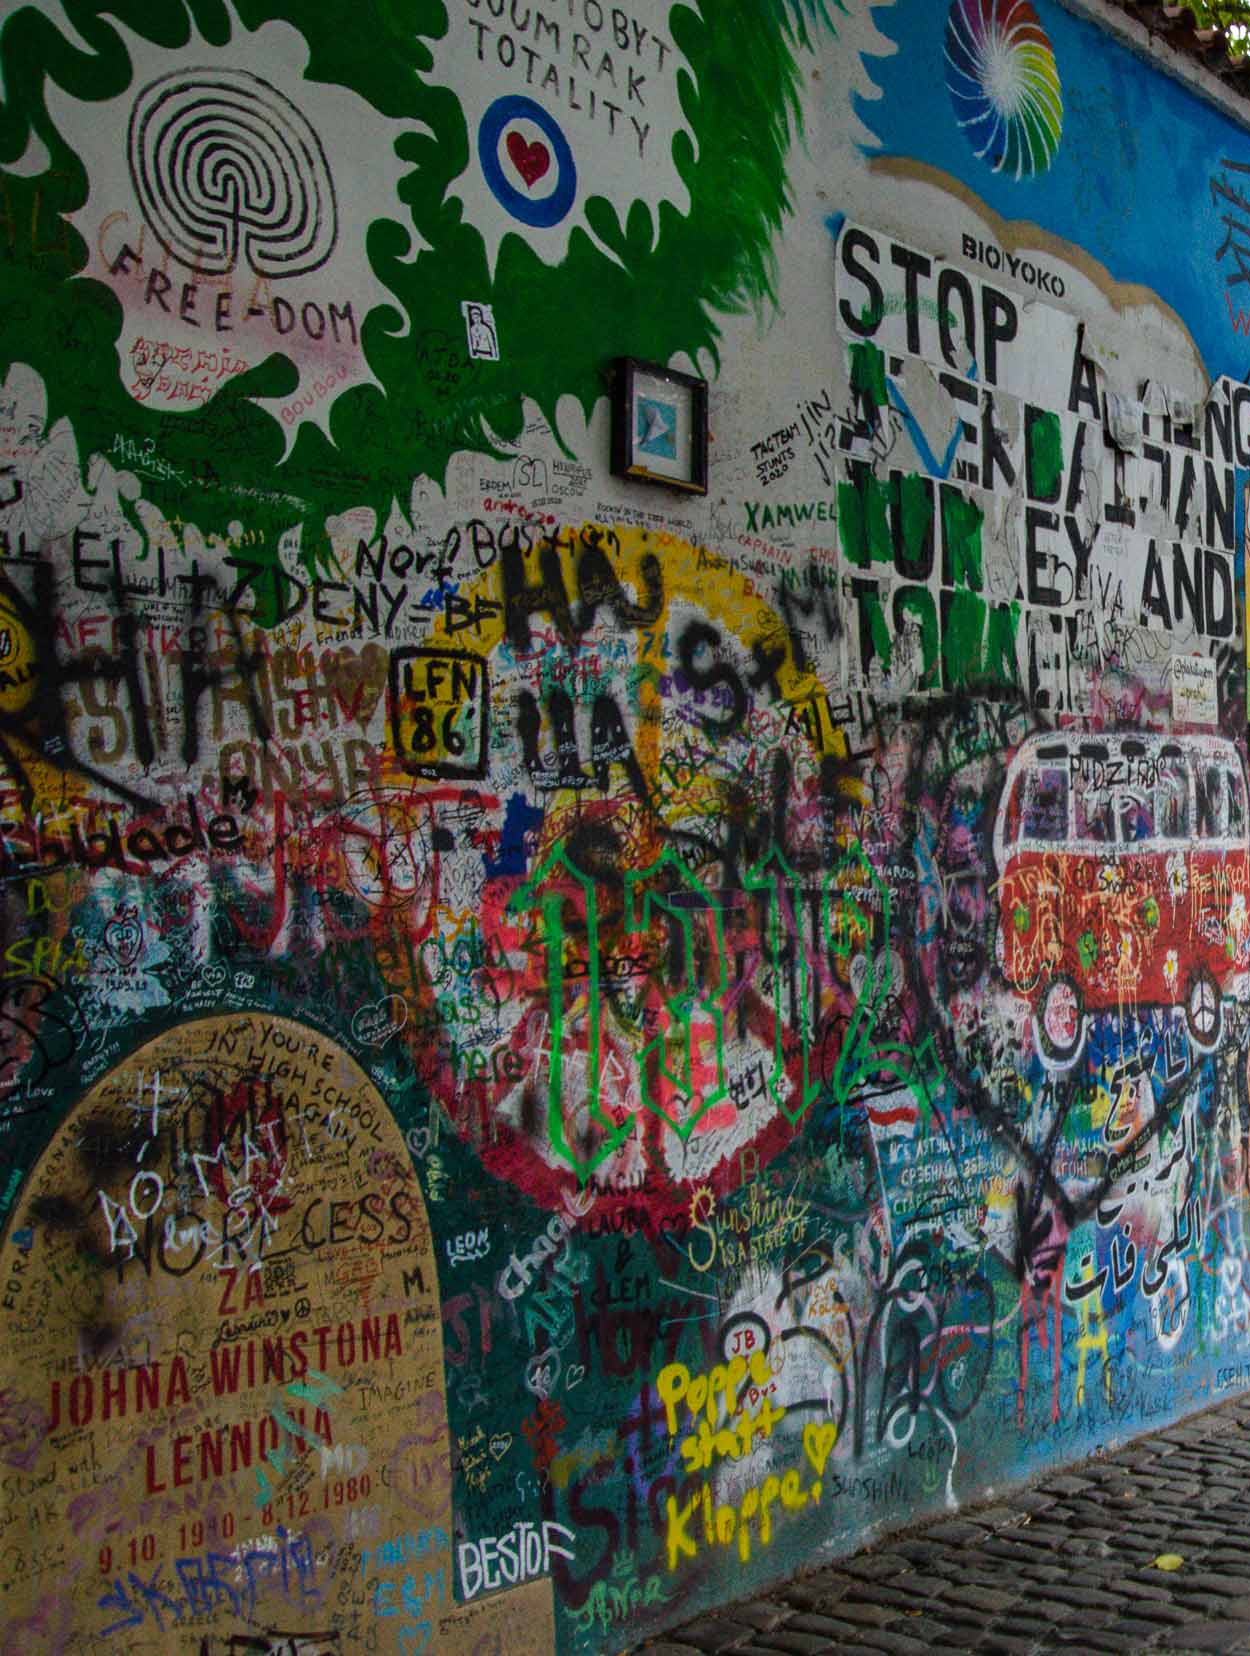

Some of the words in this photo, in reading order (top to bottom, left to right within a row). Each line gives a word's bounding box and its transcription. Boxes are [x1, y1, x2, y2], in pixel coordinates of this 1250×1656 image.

[468, 17, 651, 158] TOTALITY
[838, 226, 1019, 387] STOP
[1140, 538, 1237, 640] AND
[402, 661, 478, 701] LFN
[246, 1045, 308, 1088] HIGH
[311, 1077, 383, 1143] SCHOOL
[446, 1227, 490, 1257] LEON
[218, 1267, 265, 1316] ZA
[46, 1355, 194, 1436] JOHNA
[210, 1313, 403, 1397] WINSTONA
[145, 1405, 334, 1495] LENNONA
